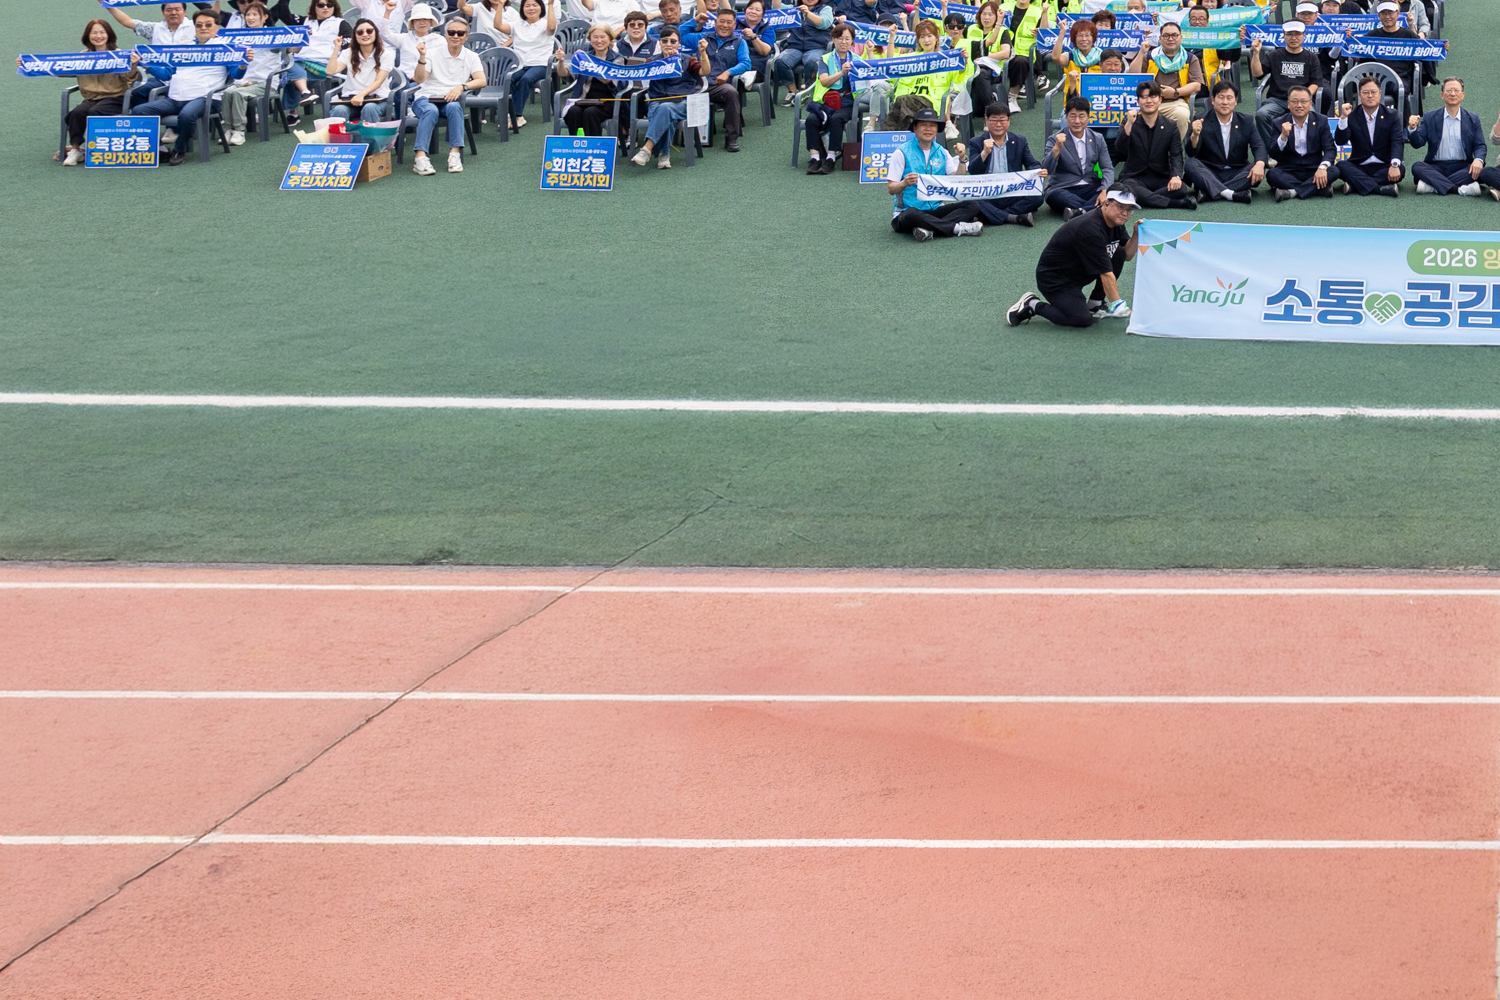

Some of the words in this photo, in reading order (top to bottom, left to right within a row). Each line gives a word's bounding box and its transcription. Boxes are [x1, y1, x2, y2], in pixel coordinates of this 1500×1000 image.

[769, 13, 796, 26] 화이팅
[233, 33, 274, 46] 주민자치
[274, 31, 304, 44] 화이팅
[1110, 37, 1142, 48] 화이팅
[1250, 32, 1277, 43] 양주시
[1316, 33, 1345, 43] 화이팅
[141, 51, 170, 64] 양주시
[172, 51, 212, 64] 주민자치
[213, 50, 244, 62] 화이팅
[1348, 44, 1375, 56] 양주시
[1376, 45, 1411, 57] 주민자치
[1413, 46, 1443, 57] 화이팅
[24, 60, 53, 72] 양주시
[53, 59, 95, 71] 주민자치
[95, 58, 129, 70] 화이팅
[858, 65, 886, 78] 양주시
[889, 61, 928, 75] 주민자치
[929, 57, 959, 70] 화이팅
[95, 136, 150, 152] 옥정2동
[91, 151, 155, 165] 주민자치회
[551, 157, 606, 173] 회천2동
[296, 161, 352, 176] 옥정1동
[287, 175, 353, 188] 주민자치회
[546, 172, 610, 188] 주민자치회
[926, 184, 959, 197] 양주시
[960, 184, 1004, 198] 주민자치
[1006, 179, 1037, 192] 화이팅
[1423, 247, 1478, 268] 2026
[1262, 278, 1366, 326] 소통
